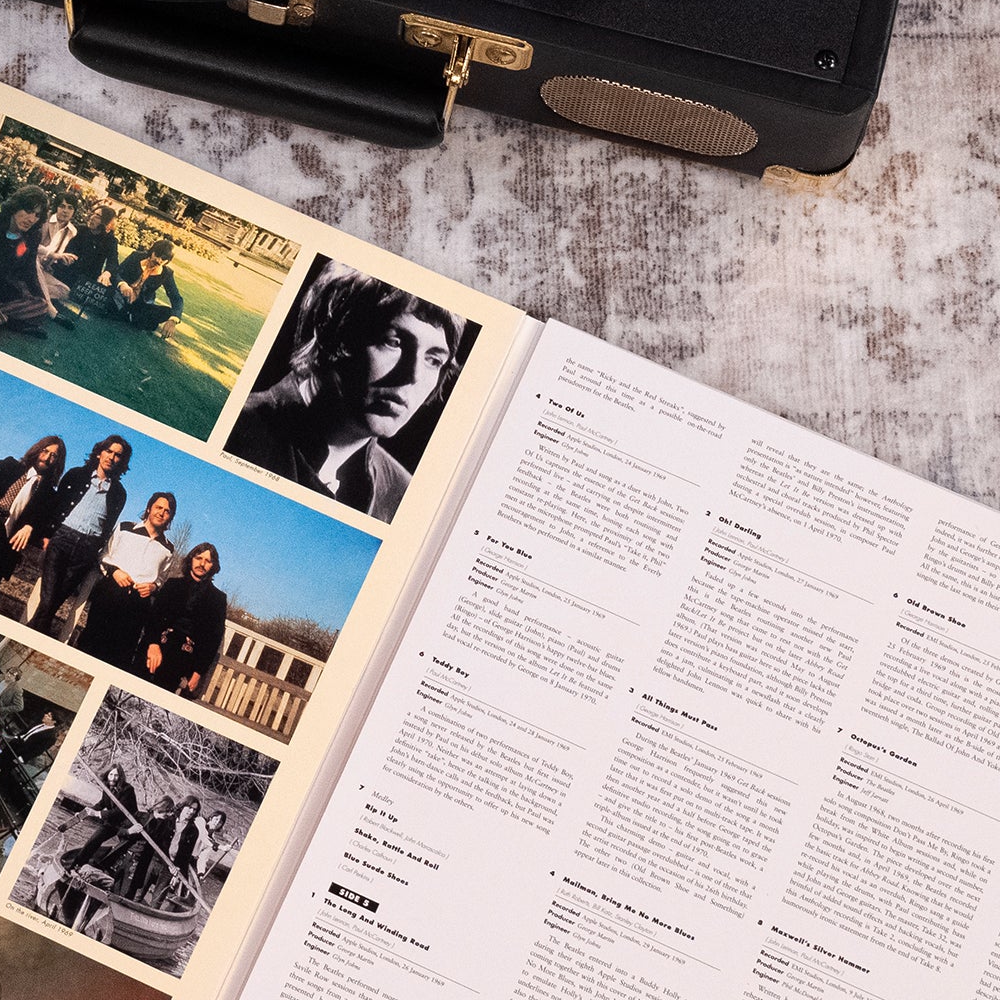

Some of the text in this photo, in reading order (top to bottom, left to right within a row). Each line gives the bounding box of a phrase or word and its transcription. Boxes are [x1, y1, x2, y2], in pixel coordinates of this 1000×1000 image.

[548, 398, 562, 408] Two
[575, 410, 584, 418] Us
[718, 515, 732, 526] Oh!
[733, 522, 761, 540] Darling
[486, 534, 499, 544] For
[501, 540, 514, 551] You
[515, 548, 532, 559] Blue
[906, 597, 920, 608] Old
[921, 604, 945, 619] Brown
[947, 616, 966, 628] Shoe
[432, 655, 453, 671] Teddy
[455, 666, 469, 678] Boy
[641, 693, 653, 702] All
[654, 698, 678, 713] Things
[680, 710, 699, 722] Must
[700, 719, 718, 731] Pass
[850, 733, 886, 753] Octopus's
[888, 750, 917, 767] Garden
[364, 802, 377, 813] Rip
[387, 813, 398, 823] Up
[353, 827, 439, 870] Shake, Rattle And Roll
[343, 851, 408, 886] Blue Suede Shoes
[338, 888, 370, 907] SIDE 5
[562, 876, 598, 897] Mailman,
[600, 893, 622, 908] Bring
[623, 904, 636, 914] Me
[638, 910, 649, 920] No
[651, 916, 672, 930] More
[673, 926, 695, 940] Blues
[323, 897, 337, 908] The
[338, 904, 357, 918] Long
[358, 914, 375, 925] And
[376, 921, 408, 942] Winding
[409, 937, 430, 951] Road
[770, 925, 810, 947] Maxwell's
[812, 944, 836, 958] Silver
[837, 955, 870, 974] Hammer
